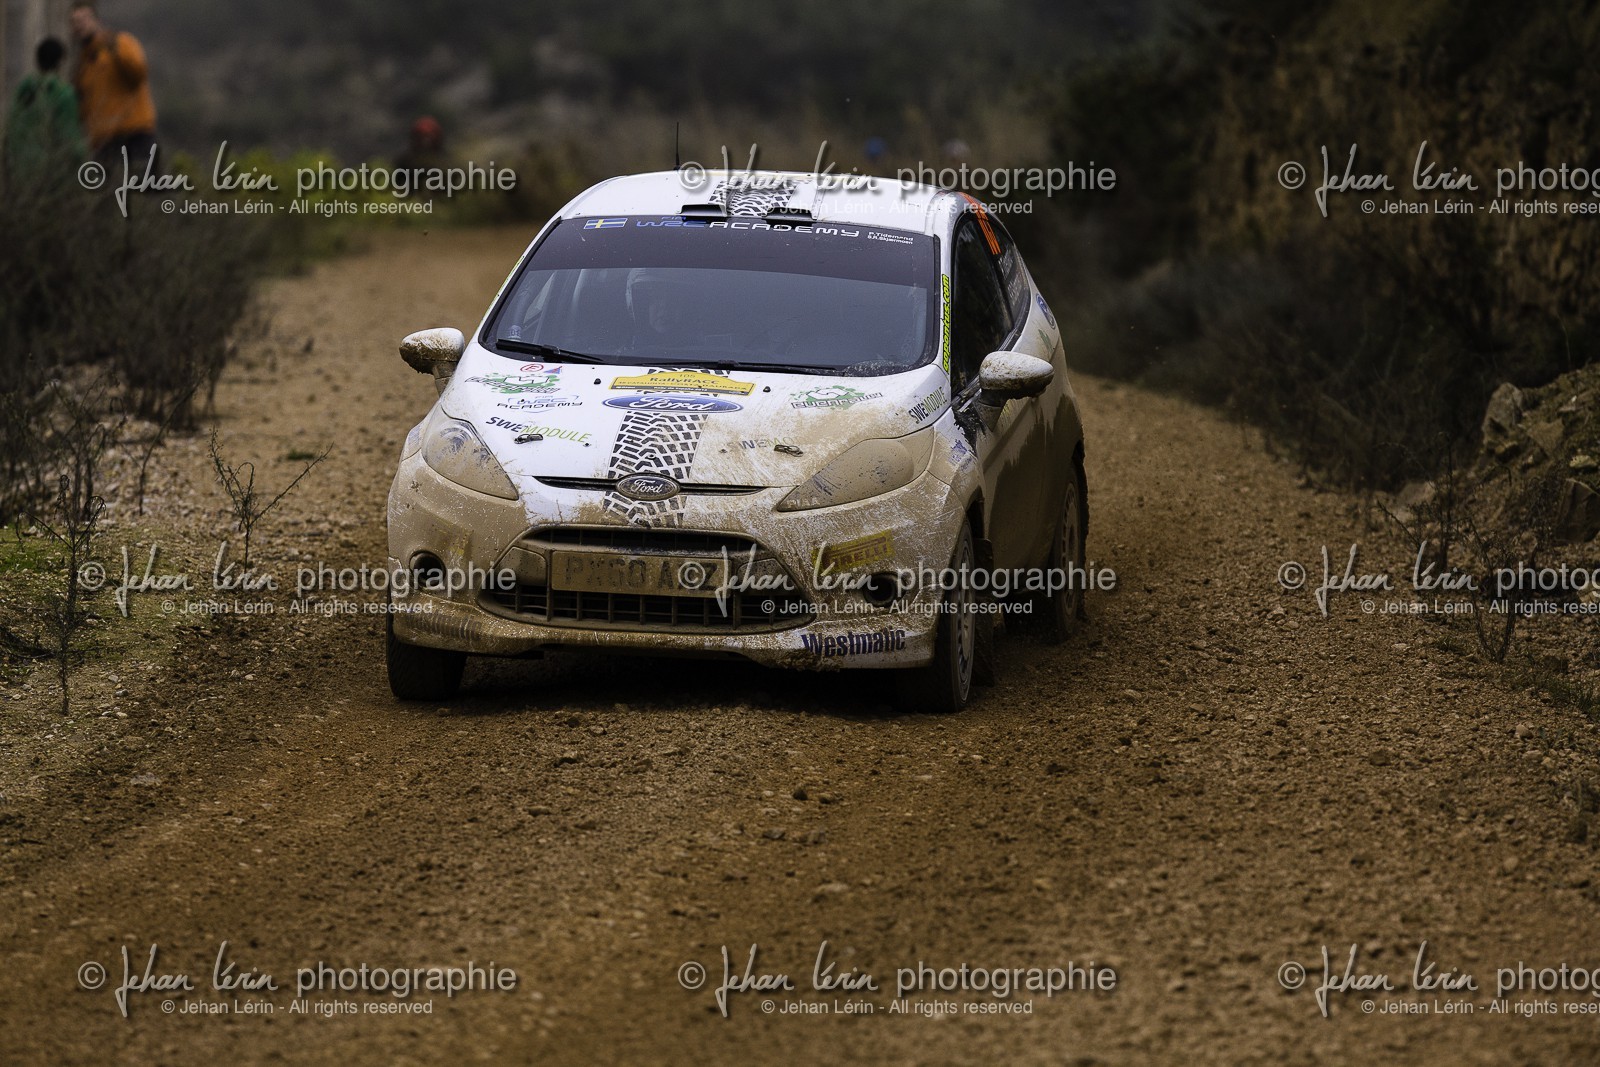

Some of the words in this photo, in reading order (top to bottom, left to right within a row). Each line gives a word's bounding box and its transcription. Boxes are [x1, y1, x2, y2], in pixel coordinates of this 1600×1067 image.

[708, 221, 860, 238] ACADEMY
[649, 377, 720, 385] RallyRACC
[497, 402, 583, 410] ACADEMY
[629, 396, 718, 411] Ford
[908, 386, 948, 425] SWEMODULE
[486, 416, 592, 443] SWEMODULE
[630, 479, 664, 493] Ford
[801, 626, 906, 657] Westmatic
